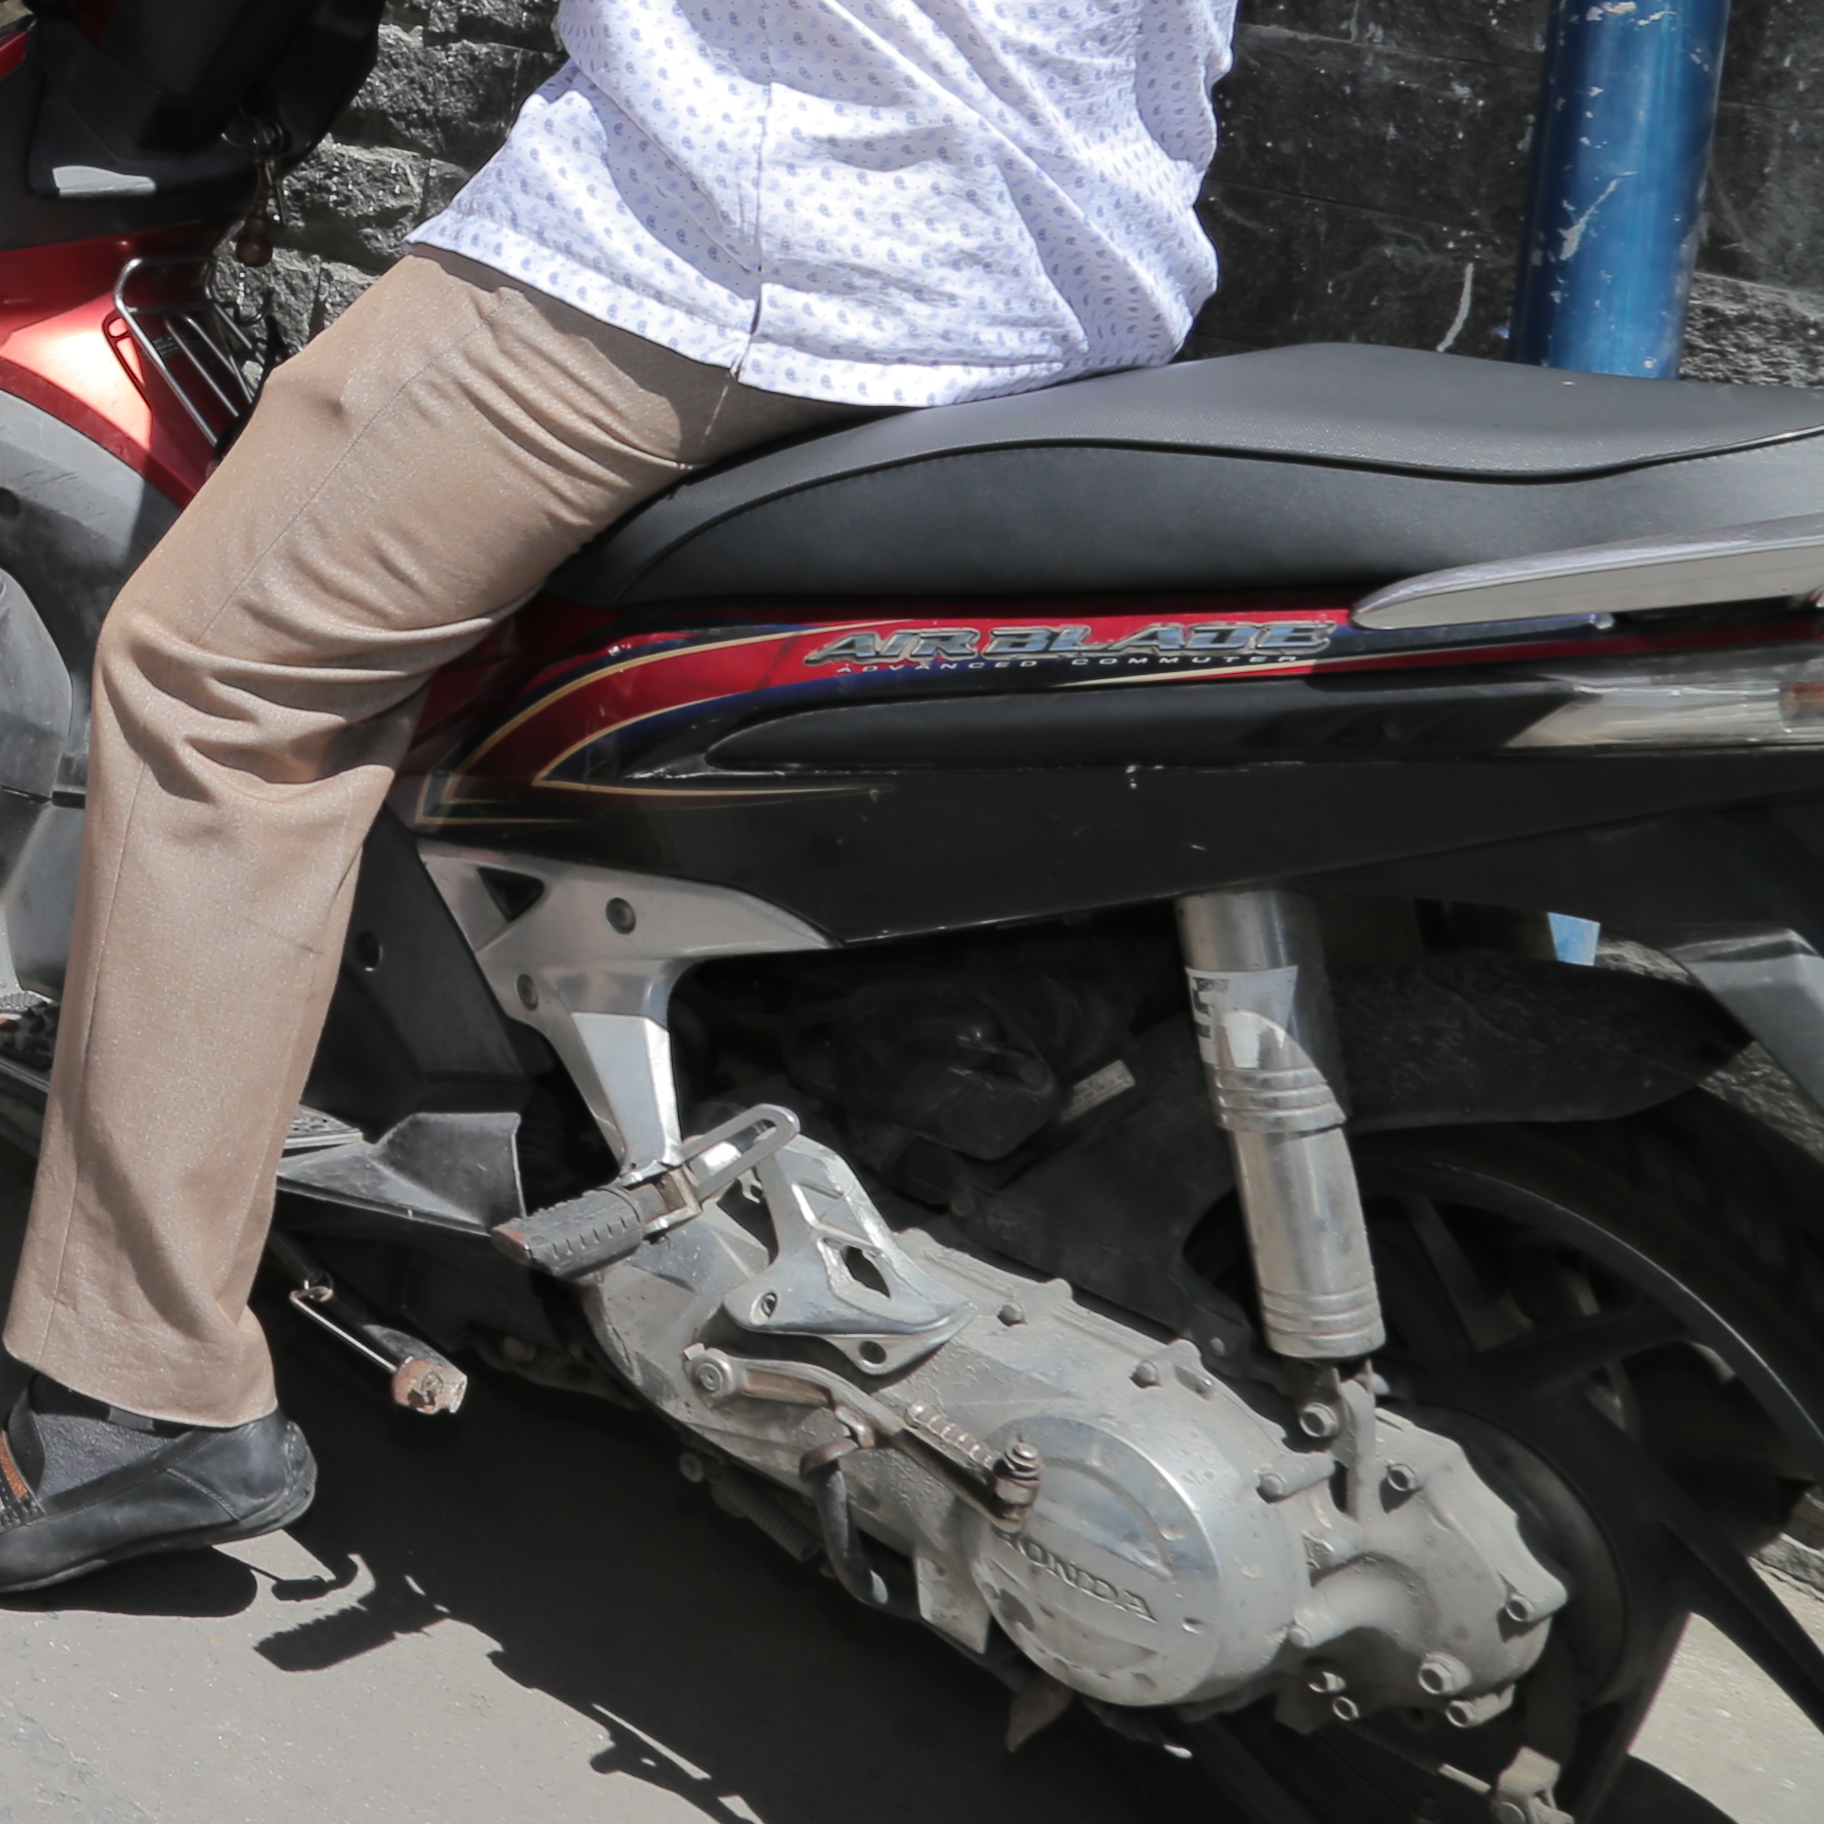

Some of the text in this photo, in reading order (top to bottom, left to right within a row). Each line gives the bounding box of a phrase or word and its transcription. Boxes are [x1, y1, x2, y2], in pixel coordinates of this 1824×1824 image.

[801, 620, 1338, 666] AIR BLADE
[836, 653, 1298, 674] ADVANCED COMMUTER
